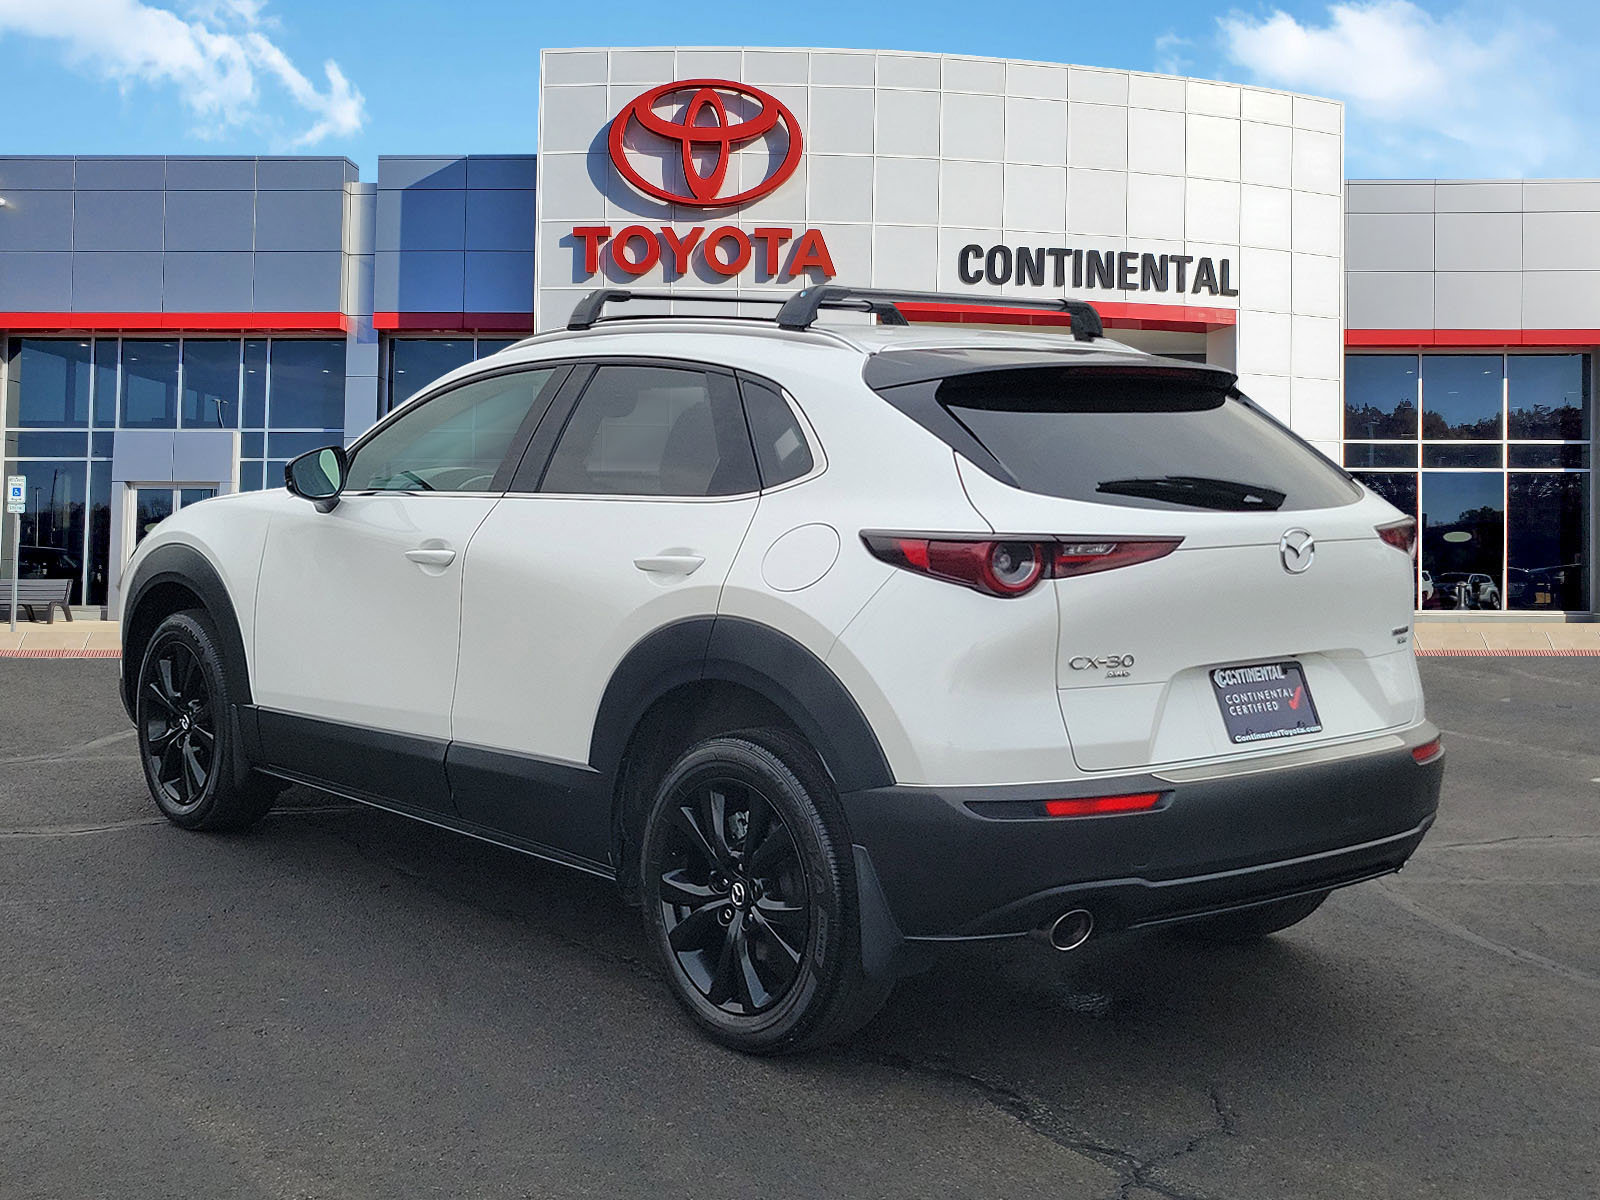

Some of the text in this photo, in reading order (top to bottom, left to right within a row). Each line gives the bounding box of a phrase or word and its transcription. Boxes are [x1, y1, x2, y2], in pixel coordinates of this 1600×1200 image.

[572, 225, 837, 277] TOYOTA
[958, 244, 1239, 297] CONTINENTAL
[1068, 653, 1135, 671] CX-30
[1214, 664, 1285, 688] CONTINENTAL
[1225, 687, 1294, 705] CONTINENTAL
[1229, 701, 1279, 716] CERTIFIED
[1235, 725, 1322, 742] ContinentalToyota.com
